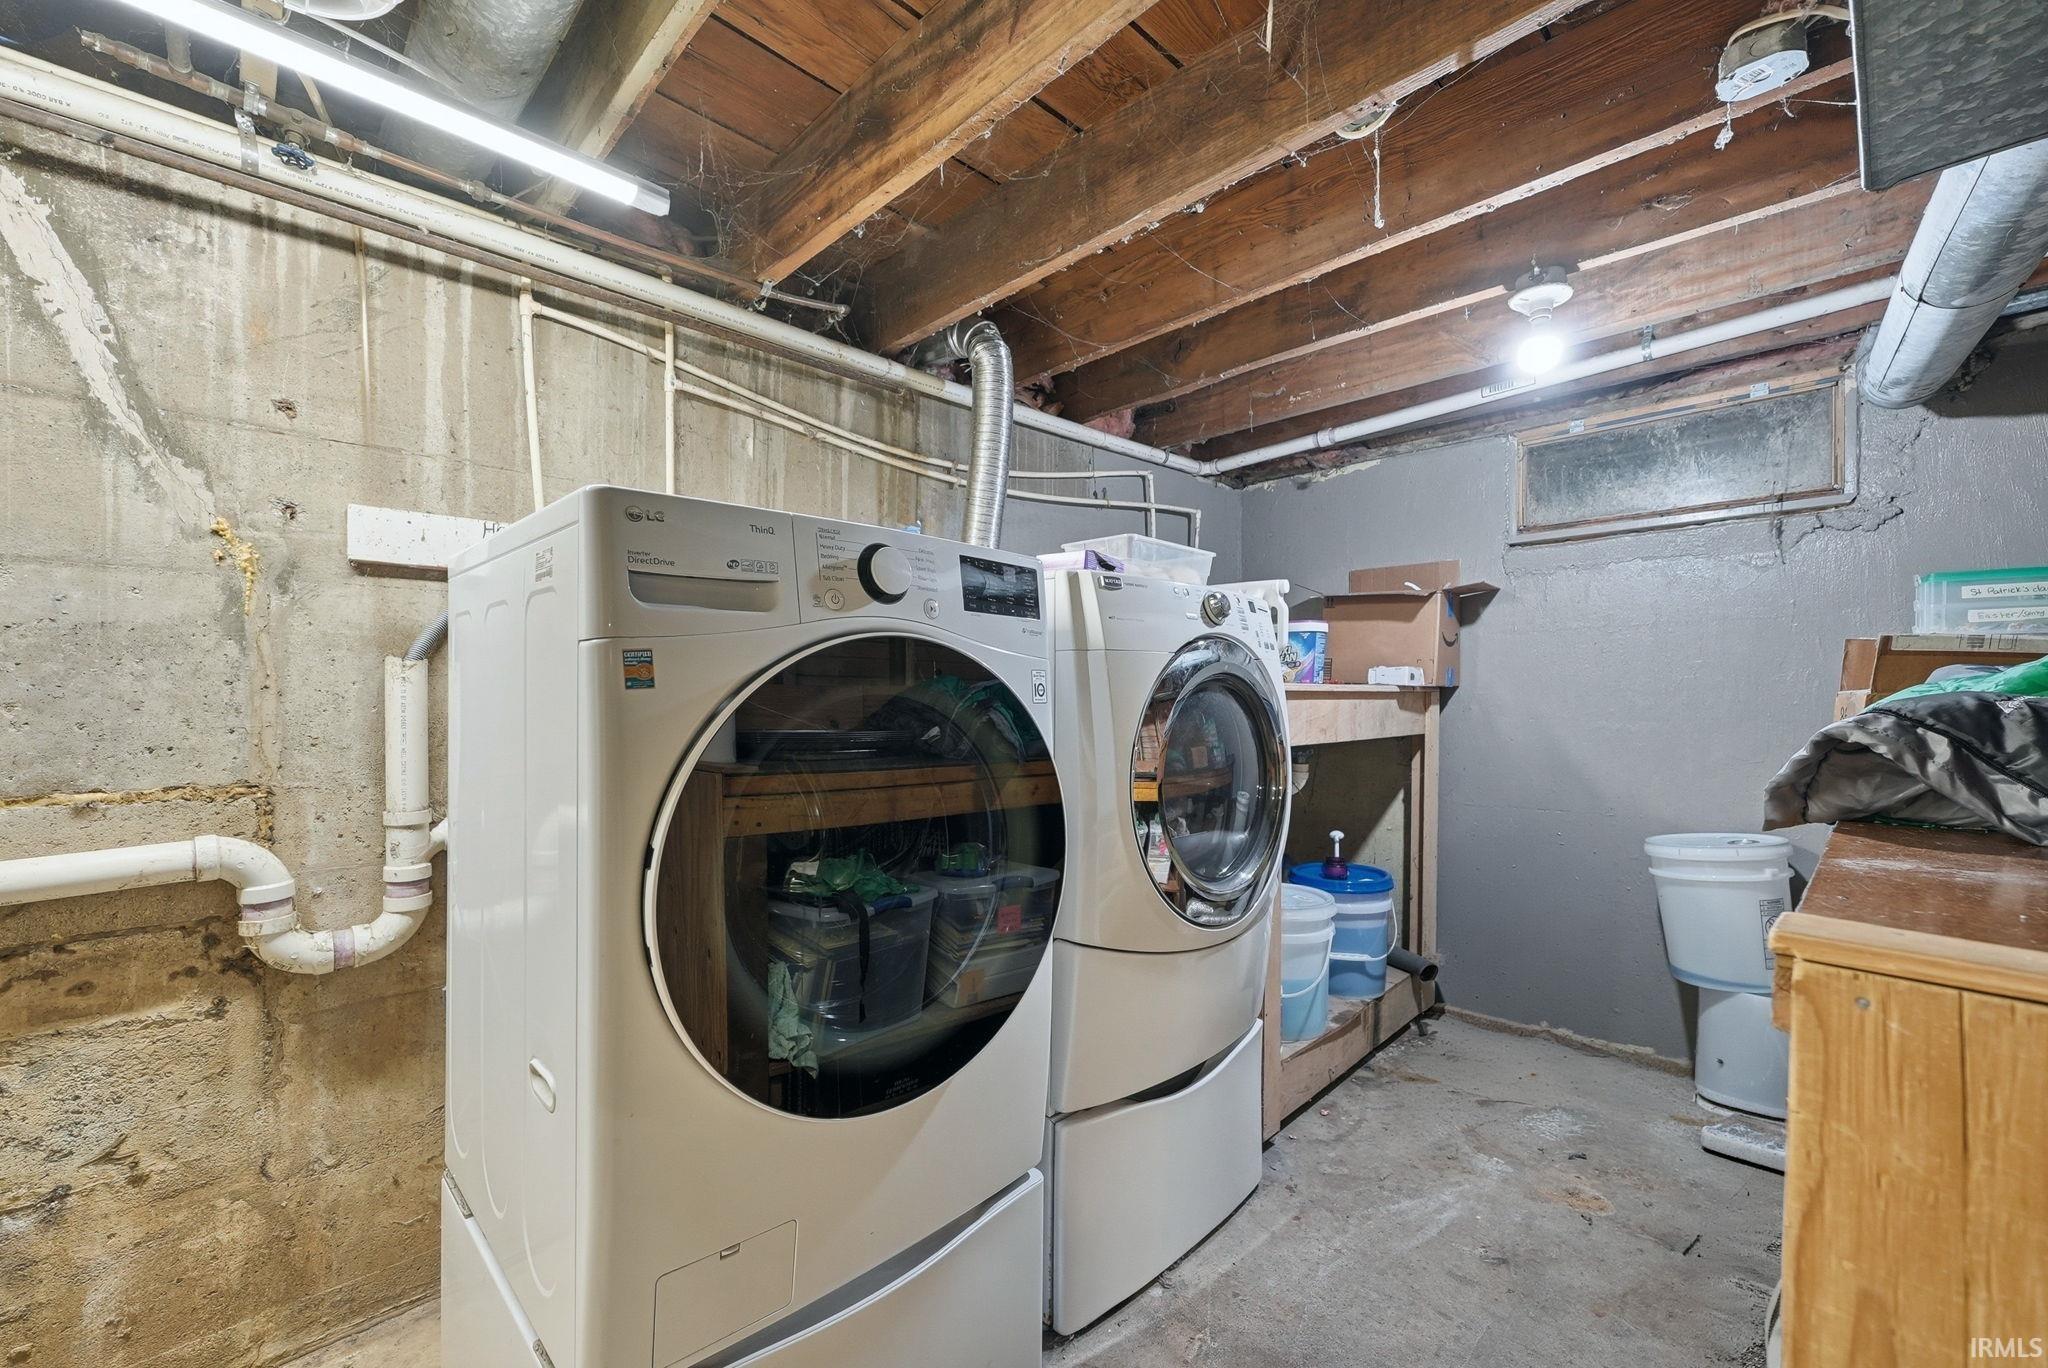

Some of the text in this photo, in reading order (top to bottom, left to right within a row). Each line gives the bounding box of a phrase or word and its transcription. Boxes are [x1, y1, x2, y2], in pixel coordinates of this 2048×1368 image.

[646, 510, 665, 523] LG
[627, 555, 676, 567] DirectDrive
[1987, 585, 2030, 595] Patrick's
